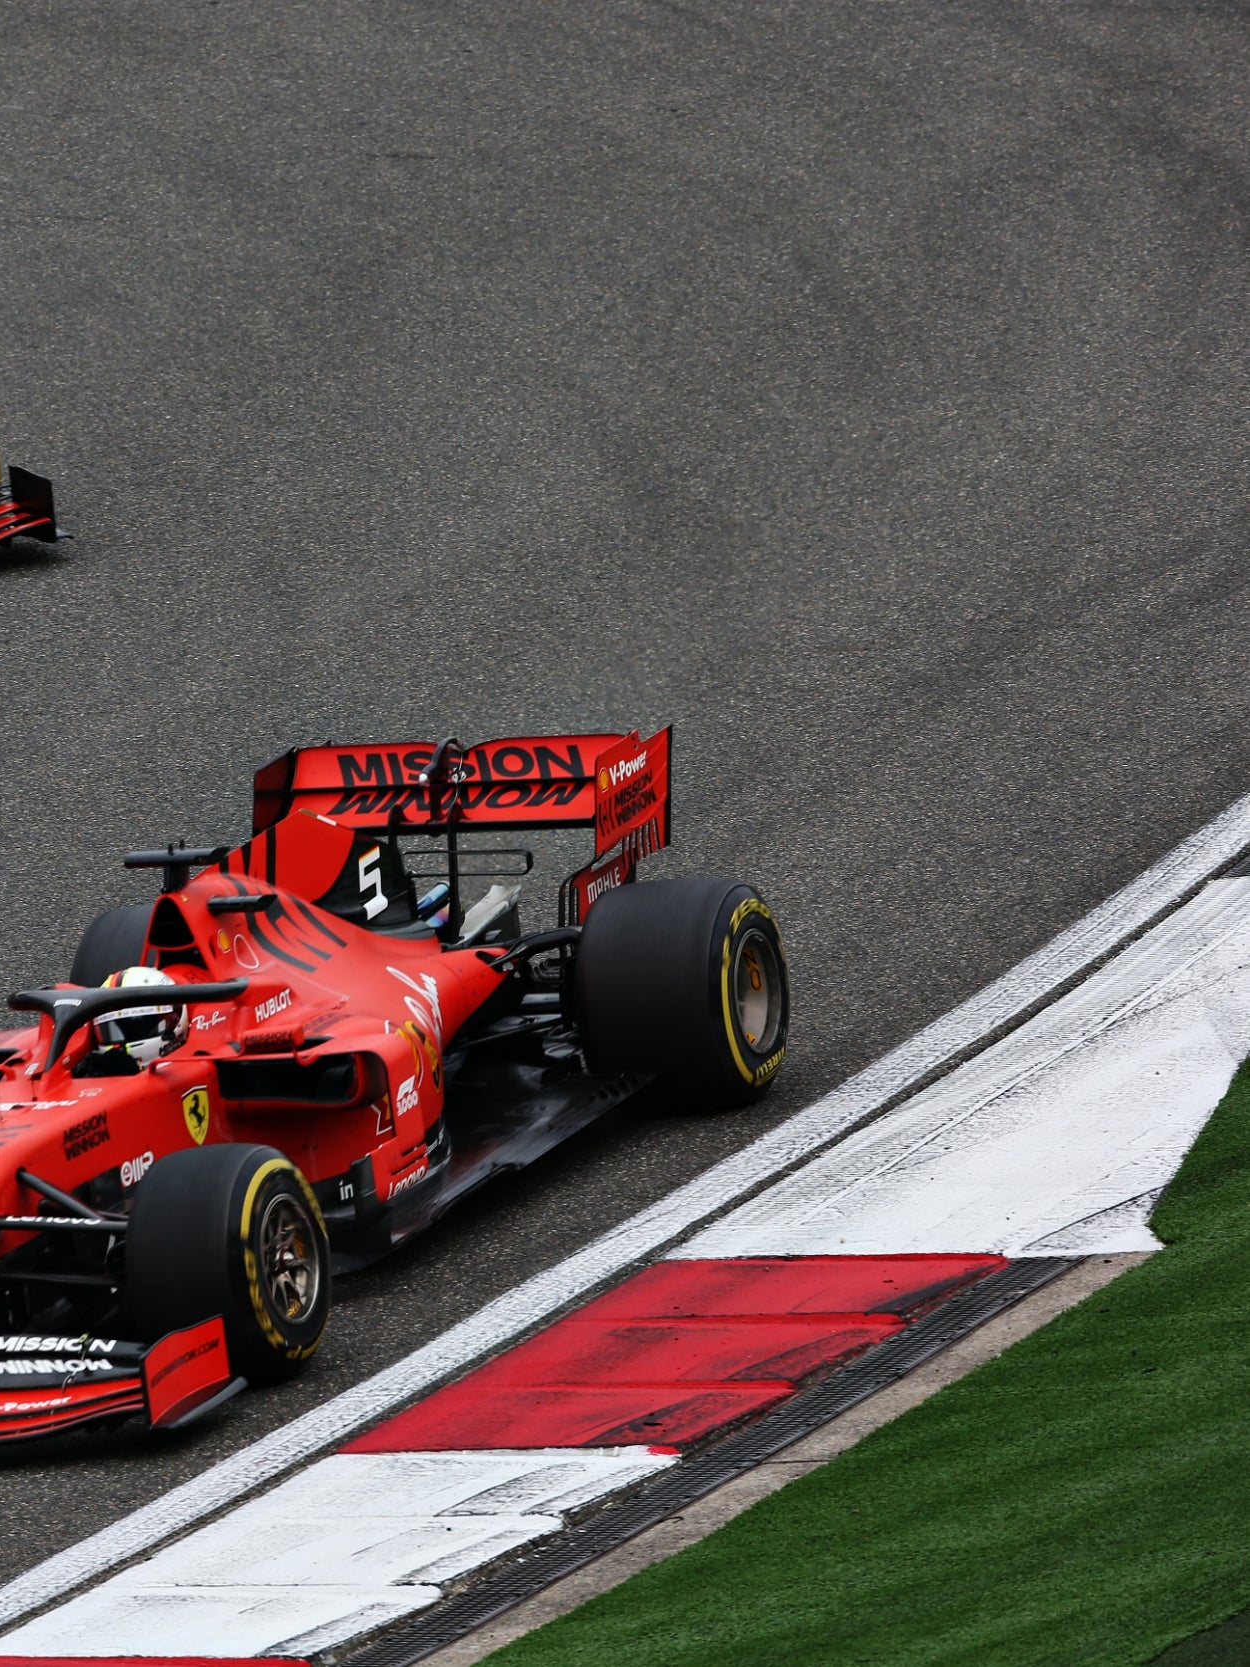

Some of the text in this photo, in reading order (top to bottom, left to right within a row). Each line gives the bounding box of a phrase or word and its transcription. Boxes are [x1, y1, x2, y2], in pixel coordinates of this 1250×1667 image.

[337, 744, 586, 787] MISSION
[608, 749, 648, 787] V-Power
[615, 767, 653, 808] MISSION
[358, 844, 388, 920] 5
[587, 866, 622, 904] MAHLE
[254, 988, 292, 1023] HUBLOT
[63, 1109, 108, 1145] MISSION
[387, 1166, 426, 1200] Lenovo
